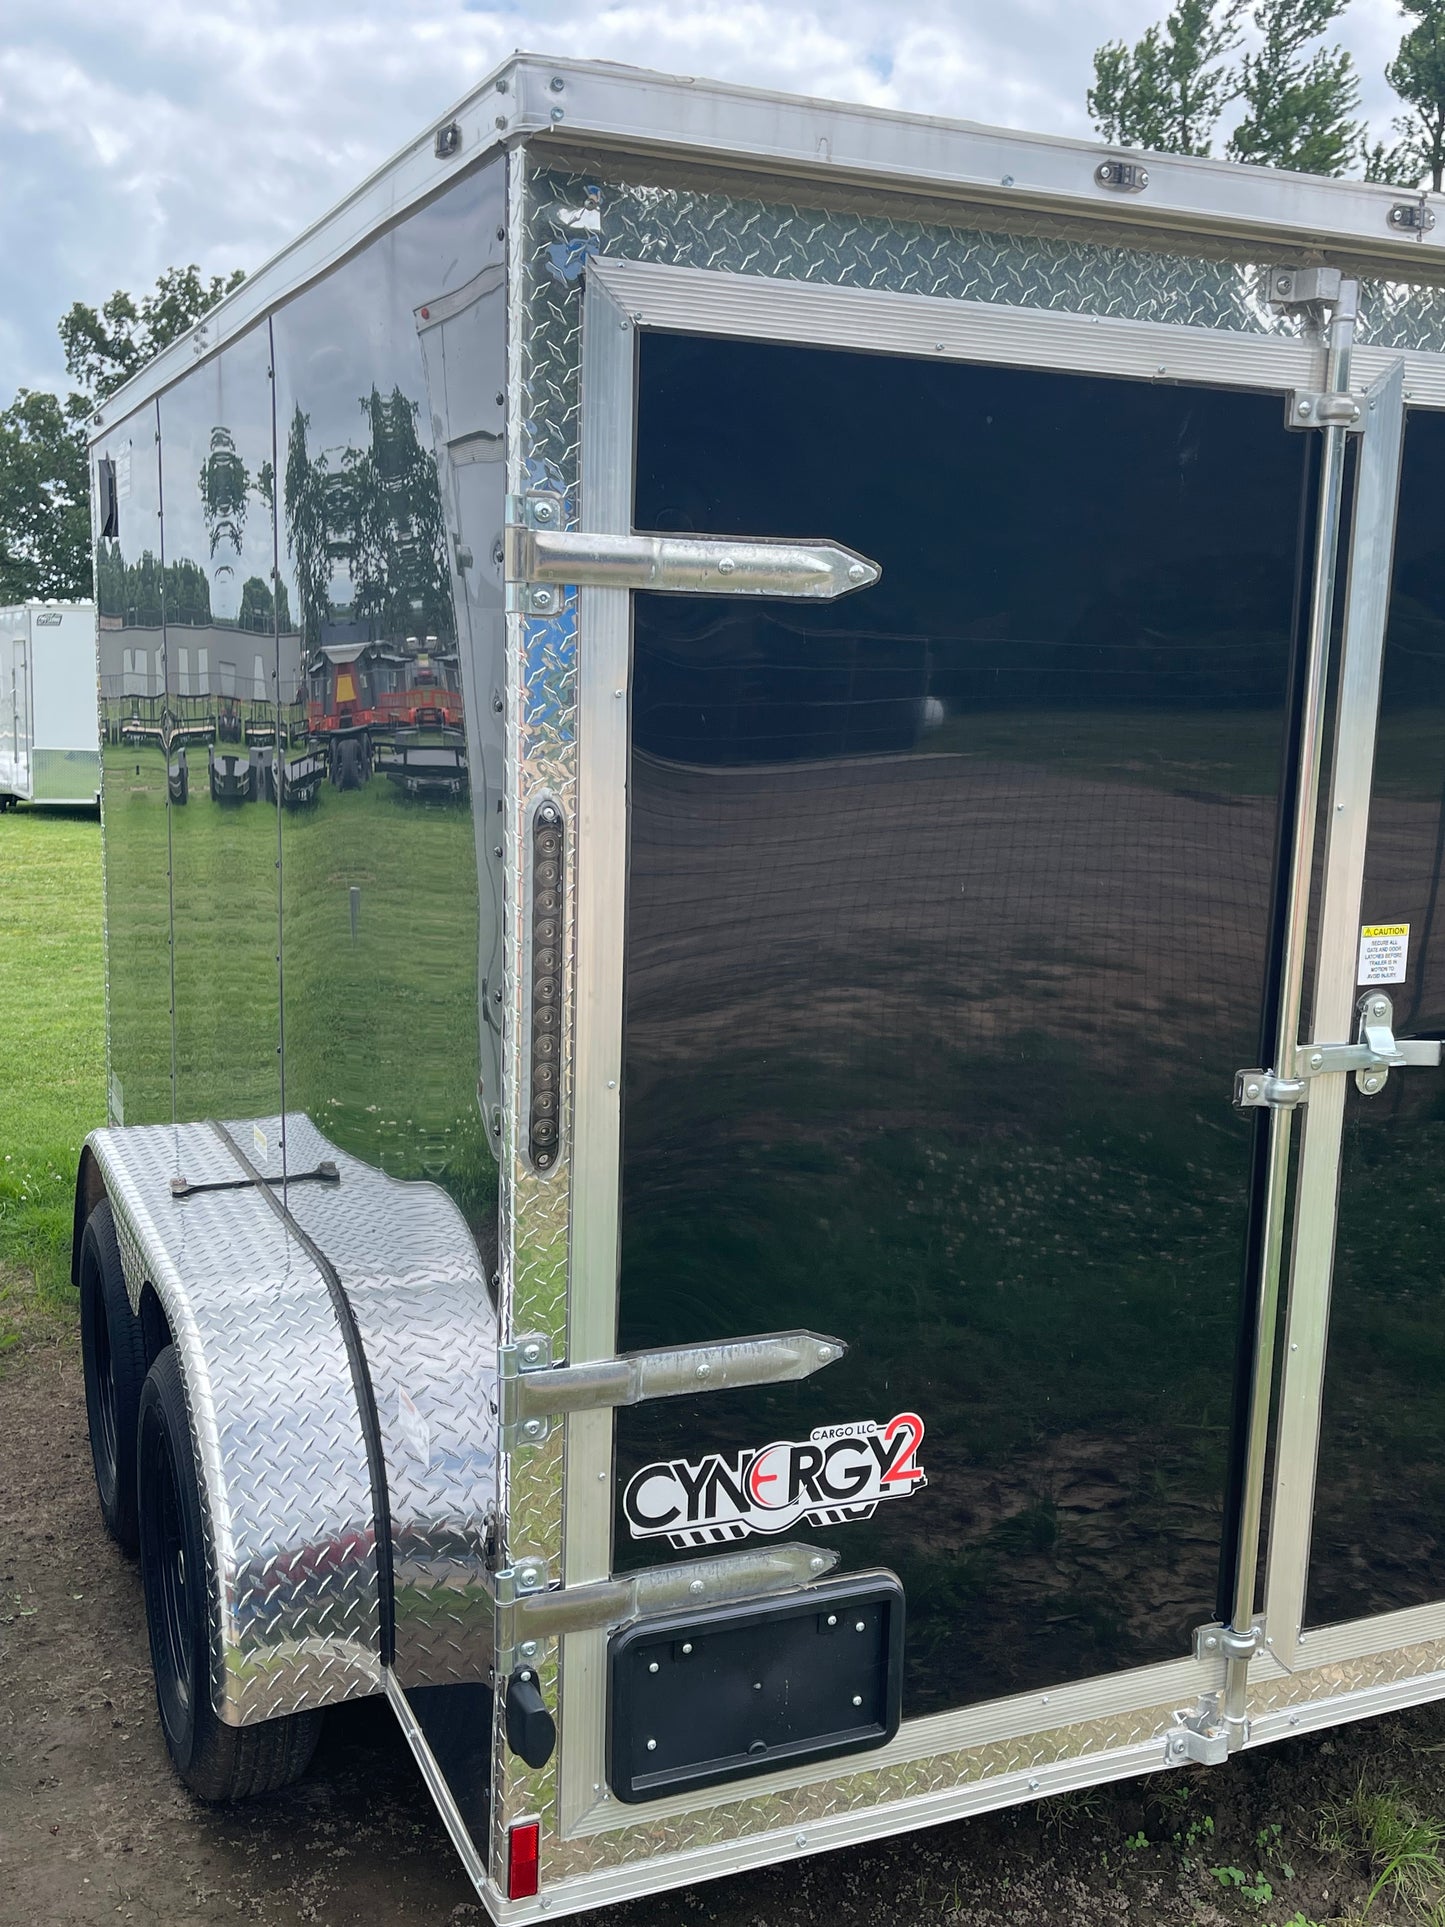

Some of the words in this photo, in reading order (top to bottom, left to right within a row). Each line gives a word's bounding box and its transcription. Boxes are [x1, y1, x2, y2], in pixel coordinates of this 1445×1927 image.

[1374, 928, 1404, 936] CAUTION
[812, 1426, 854, 1441] CARGO
[856, 1423, 876, 1435] LLC
